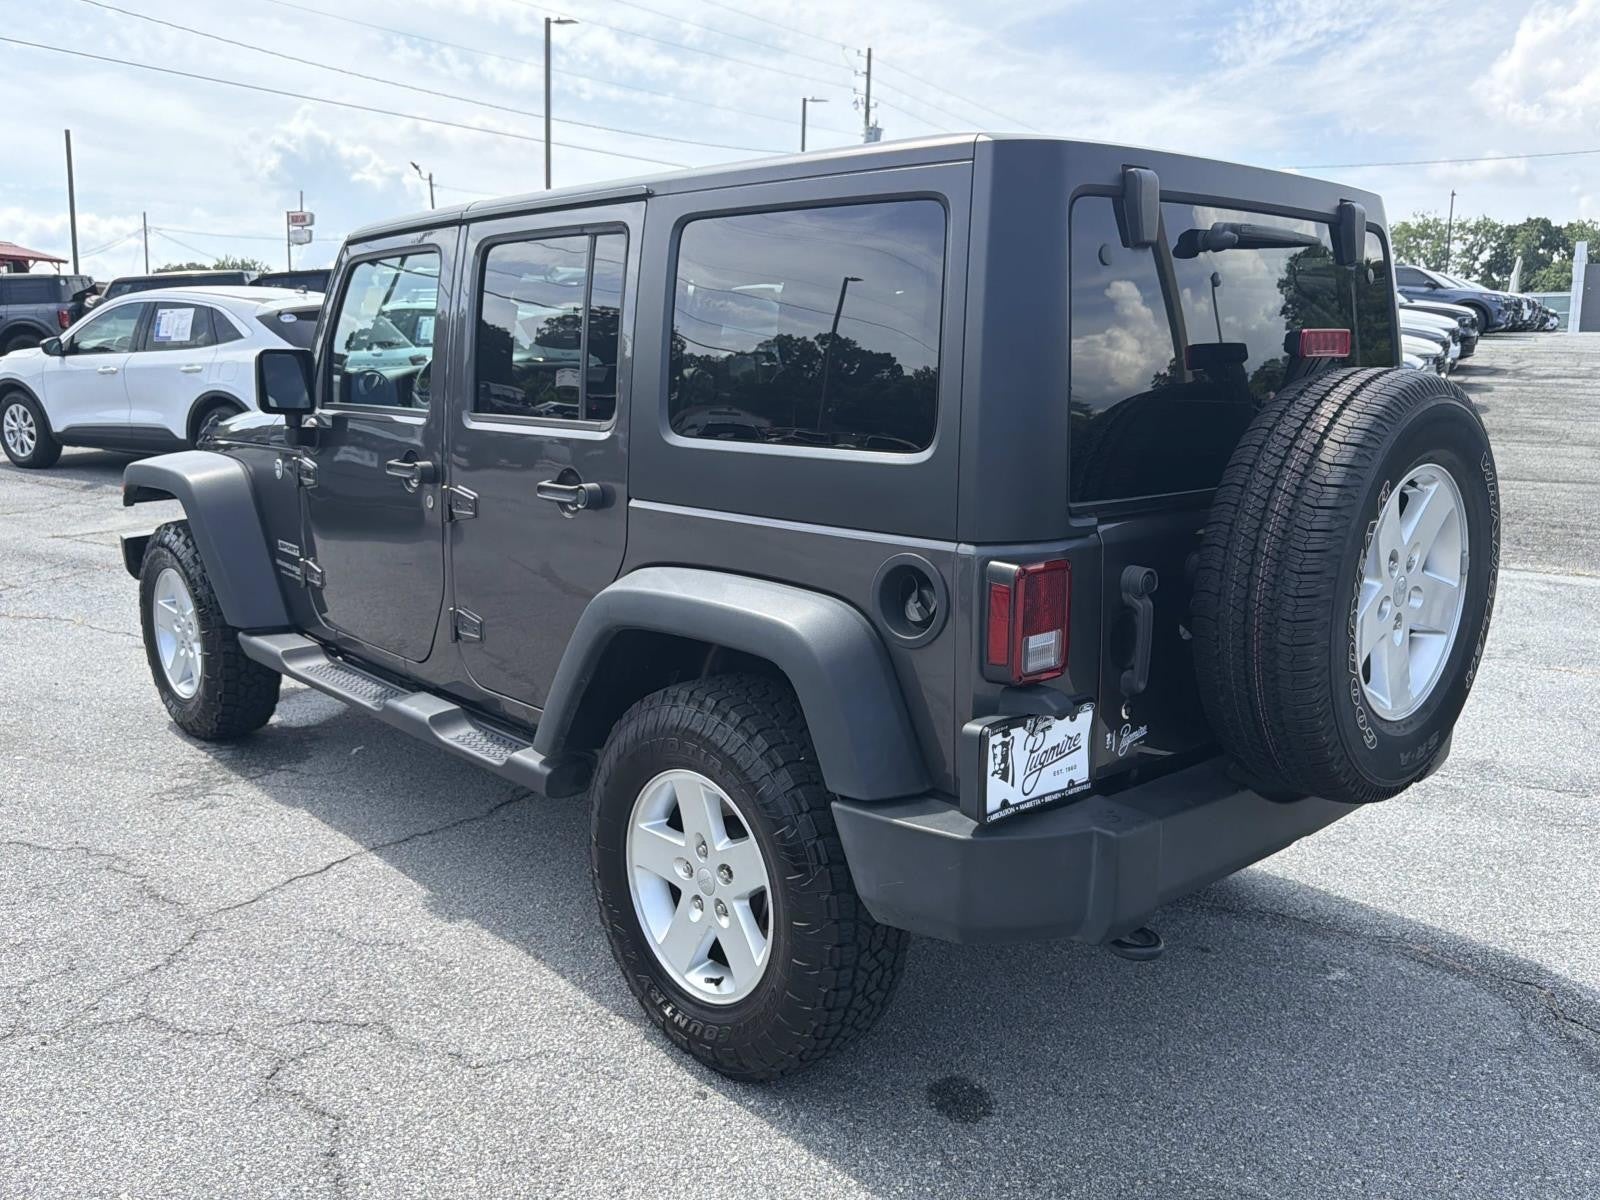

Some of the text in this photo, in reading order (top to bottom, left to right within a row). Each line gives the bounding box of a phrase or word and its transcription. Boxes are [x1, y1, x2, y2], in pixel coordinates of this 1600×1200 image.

[1348, 480, 1391, 750] GOODYEAR
[1466, 450, 1500, 689] WRANGLER
[1022, 730, 1082, 796] Pugmire
